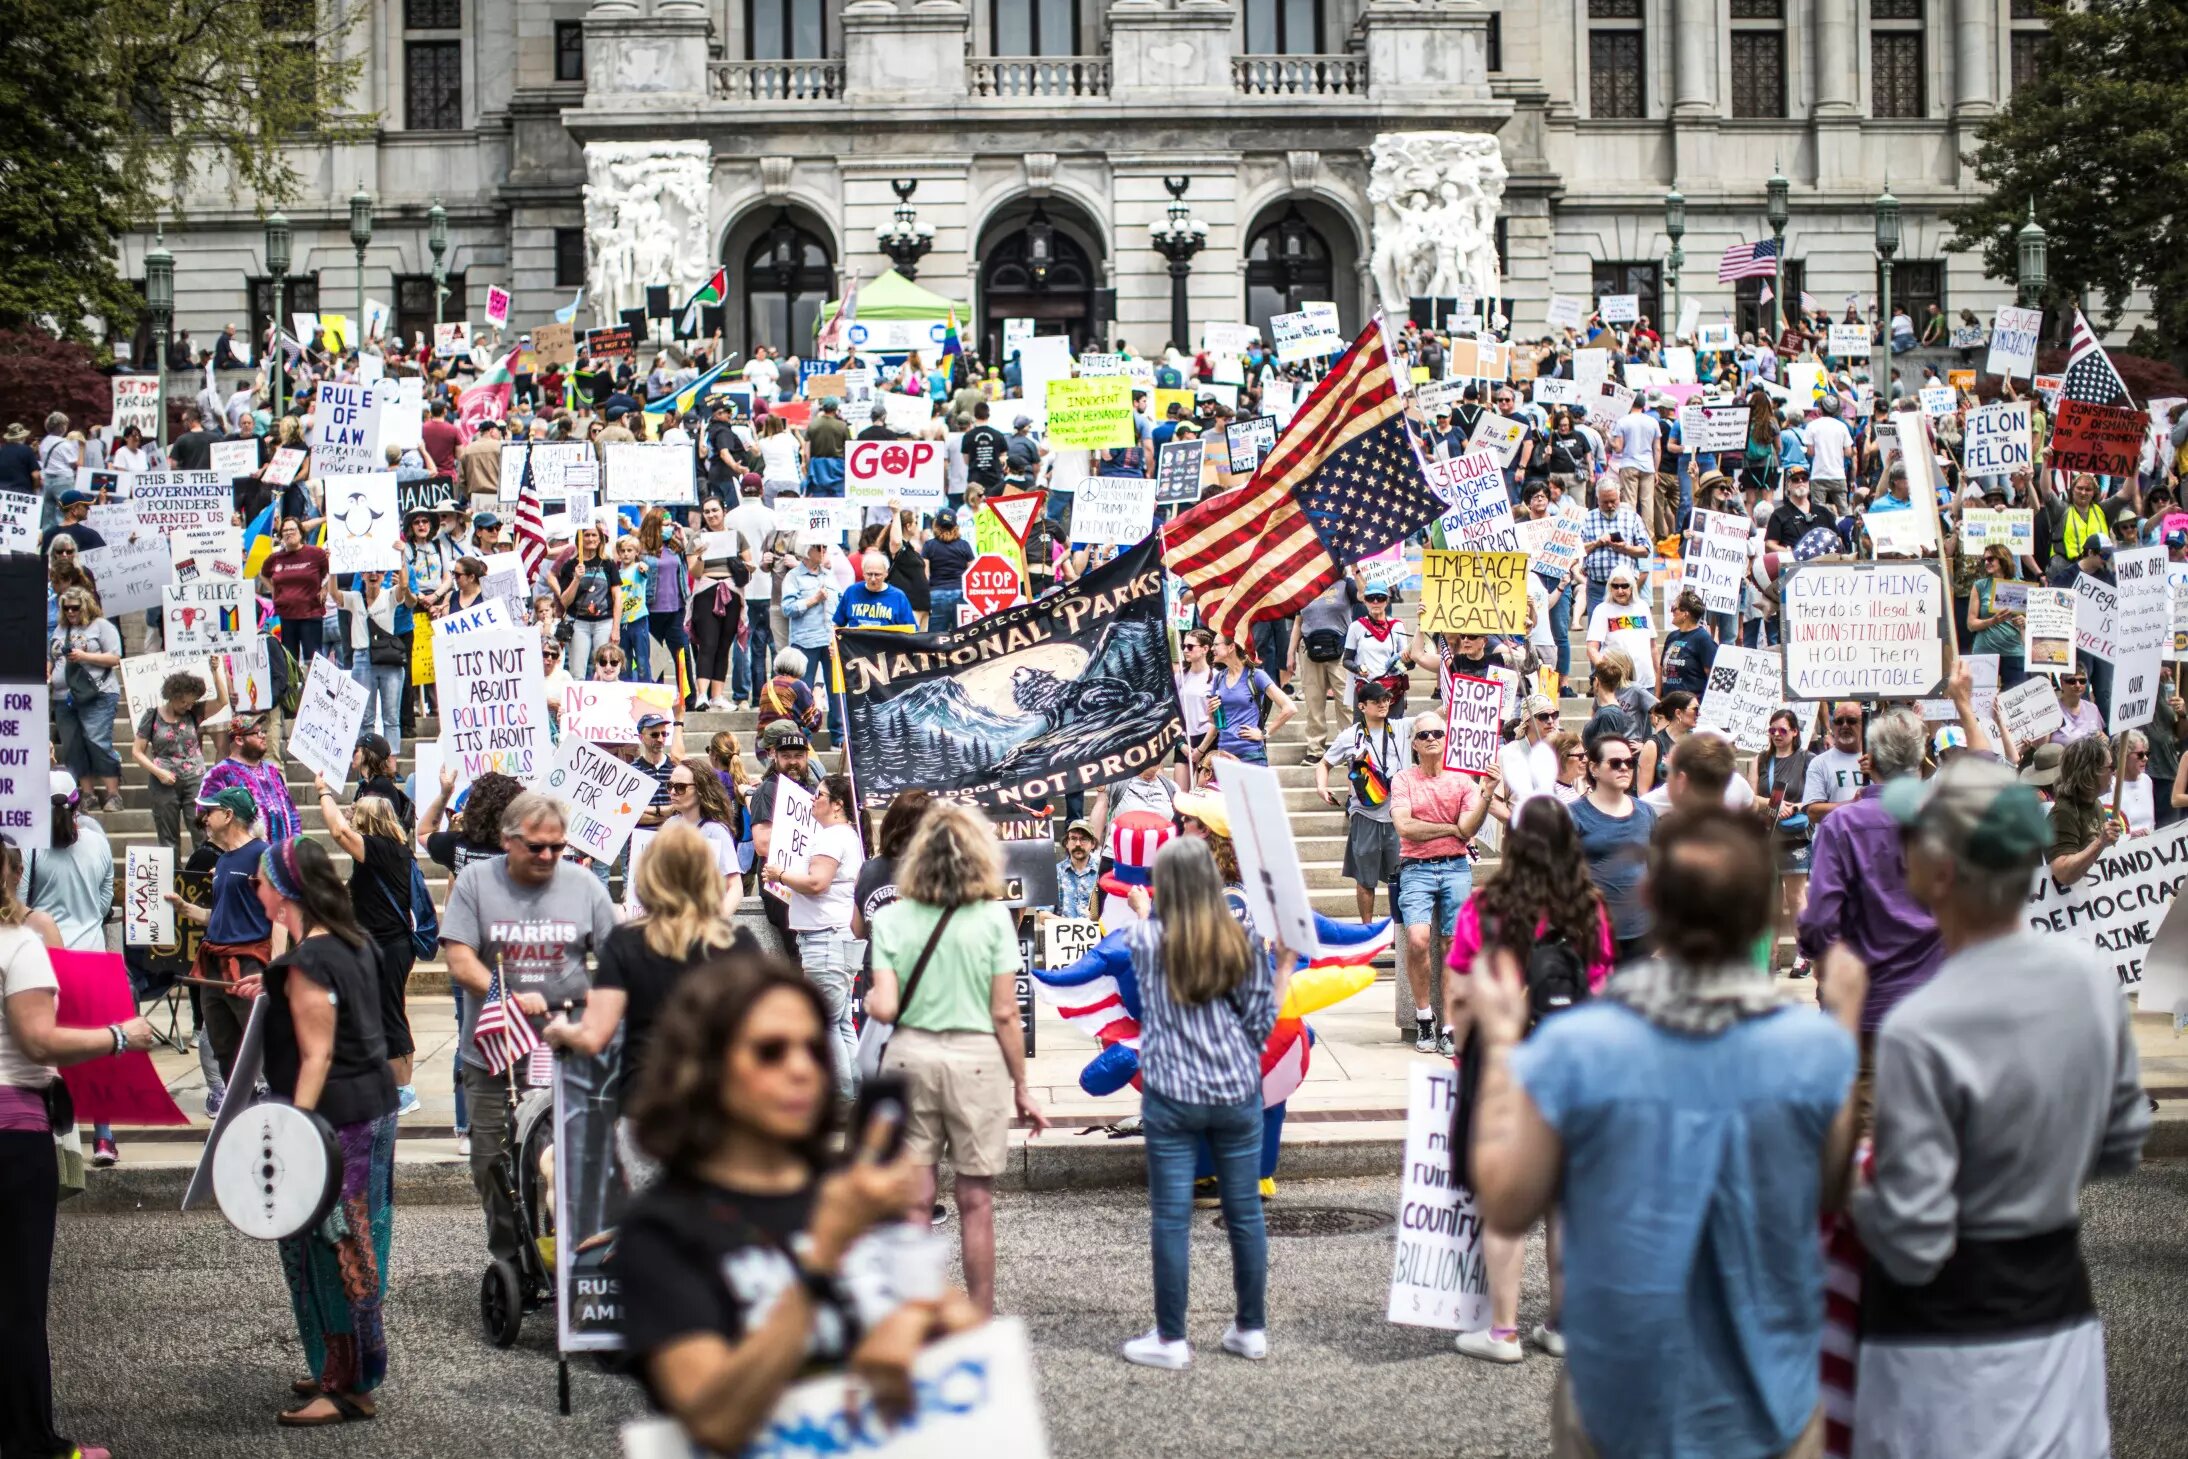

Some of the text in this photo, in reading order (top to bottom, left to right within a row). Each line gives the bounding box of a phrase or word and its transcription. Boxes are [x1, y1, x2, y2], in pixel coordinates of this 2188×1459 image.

[2000, 310, 2042, 330] SAVE
[118, 380, 160, 394] STOP
[1544, 384, 1566, 394] NOT
[116, 396, 159, 408] FASCISM
[322, 386, 373, 408] RULE
[1068, 394, 1120, 408] INNOCENT
[334, 408, 357, 425] OF
[2066, 415, 2082, 426] TO
[2071, 404, 2136, 421] CONSPIRING
[120, 414, 156, 431] NOW
[1966, 412, 2025, 438] FELON
[325, 426, 365, 446] LAW
[1484, 426, 1507, 441] This is
[1994, 436, 2010, 444] THE
[2056, 430, 2144, 443] OUR GOVERNMENT
[311, 444, 372, 459] SEPARATION
[1967, 443, 2028, 468] FELON
[2092, 443, 2104, 451] IS
[850, 442, 934, 480] GOP
[1434, 452, 1499, 487] 3 EQUAL
[2052, 452, 2139, 478] TREASON
[136, 472, 218, 486] THIS IS THE
[6, 494, 38, 505] KINGS
[135, 485, 232, 498] GOVERNMENT
[8, 504, 28, 514] THE
[148, 500, 220, 512] FOUNDERS
[1096, 502, 1128, 513] TRUMP
[1460, 494, 1480, 510] OF
[137, 512, 224, 524] WARNED US
[1442, 499, 1508, 532] GOVERNMENT
[1558, 518, 1580, 532] OF MY
[1124, 524, 1149, 540] GOD
[1552, 530, 1578, 546] RAGE
[1714, 521, 1750, 540] DICTATOR
[1990, 525, 2010, 534] ARE
[1543, 541, 1576, 560] CANNOT
[1705, 540, 1744, 564] DICTATOR
[1426, 555, 1528, 580] IMPEACH
[1701, 564, 1732, 588] DICK
[2118, 557, 2165, 580] HANDS OFF!
[126, 579, 154, 596] MTG
[970, 571, 1012, 588] STOP
[169, 585, 189, 602] WE
[968, 587, 1017, 596] SENDING BOMBS
[1700, 588, 1736, 612] TRAITOR
[851, 602, 893, 620] УКРАЇНА
[937, 608, 1030, 645] PROTECT
[1039, 586, 1081, 610] OUR
[1428, 603, 1516, 630] AGAIN
[1796, 599, 1927, 618] they do is illegal &
[444, 607, 498, 636] MAKE
[1608, 616, 1648, 632] PEACE
[2100, 614, 2112, 634] is
[846, 571, 1162, 696] NATIONAL PARKS
[1795, 621, 1930, 643] UNCONSTITUTIONAL
[170, 649, 186, 658] HATE
[188, 648, 200, 656] HAS
[455, 648, 526, 677] IT'S NOT
[1809, 646, 1919, 664] HOLD Them
[124, 660, 158, 678] Fund
[1742, 655, 1758, 674] The
[470, 678, 522, 704] ABOUT
[1456, 680, 1496, 702] STOP
[1739, 674, 1780, 701] the People
[2128, 676, 2143, 694] OUR
[4, 694, 32, 711] FOR
[336, 675, 361, 715] Veteran
[1453, 700, 1498, 726] TRUMP
[1730, 694, 1768, 718] Stronger
[2118, 698, 2149, 722] COUNTRY
[453, 703, 528, 730] POLITICS
[1728, 713, 1742, 730] the
[300, 704, 343, 759] Constitution
[568, 716, 634, 740] KINGS
[453, 726, 536, 753] IT'S ABOUT
[1449, 726, 1497, 751] DEPORT
[464, 749, 533, 778] MORALS
[997, 717, 1183, 805] NOT PROFITS
[1447, 748, 1492, 770] MUSK
[570, 745, 640, 799] STAND UP
[572, 781, 602, 810] FOR
[943, 782, 1002, 798] DOGE
[570, 812, 612, 851] OTHER
[792, 828, 808, 857] BE
[2084, 850, 2152, 888] STAND
[136, 864, 150, 924] MAD
[148, 854, 160, 942] MAD SCIENTIST
[490, 924, 577, 942] HARRIS
[502, 944, 565, 961] WALZ
[520, 974, 546, 983] 2024
[1403, 1200, 1484, 1252] country
